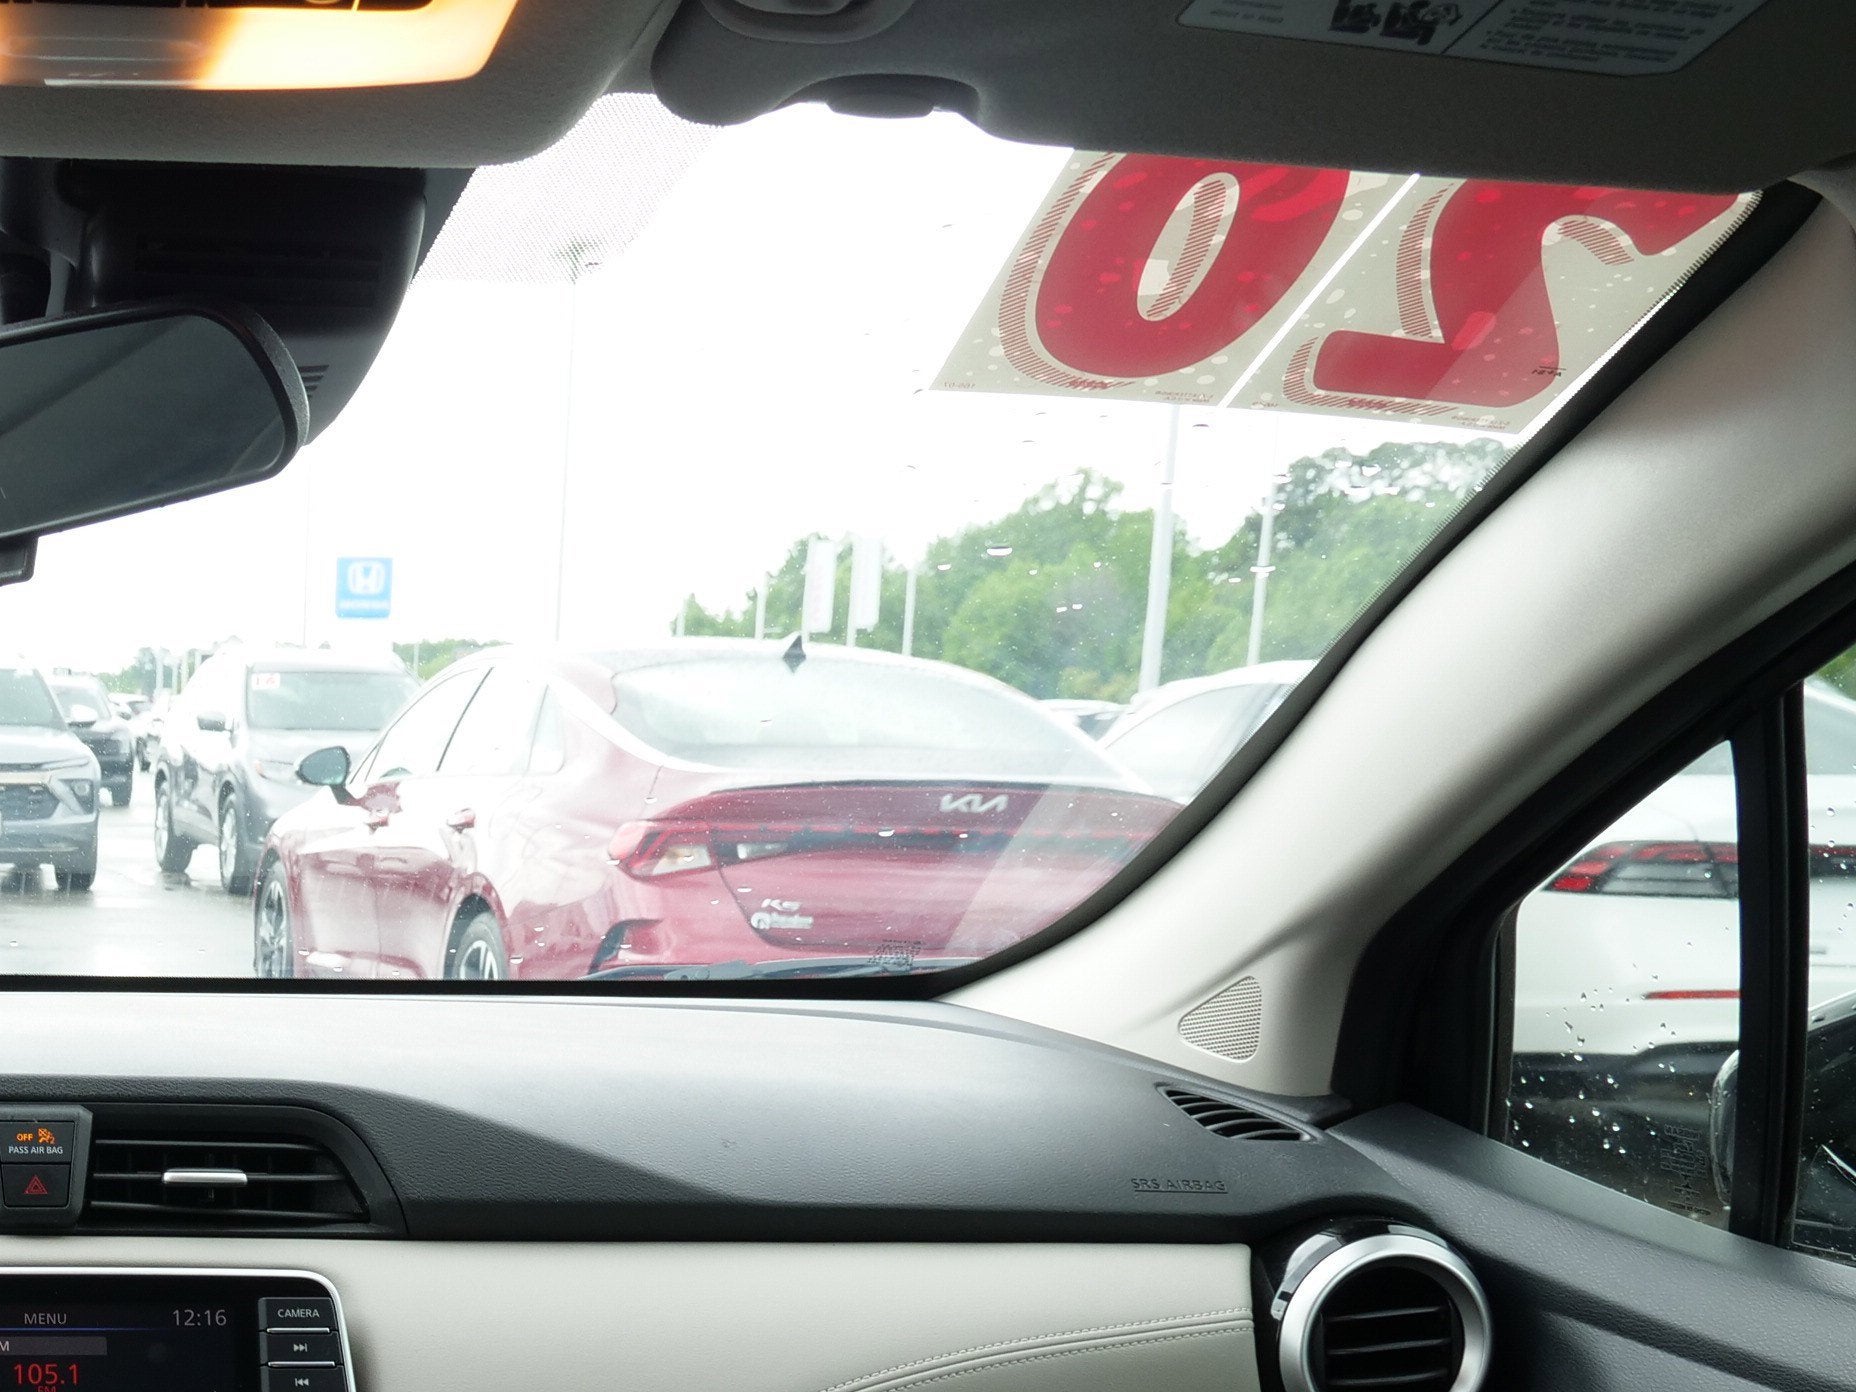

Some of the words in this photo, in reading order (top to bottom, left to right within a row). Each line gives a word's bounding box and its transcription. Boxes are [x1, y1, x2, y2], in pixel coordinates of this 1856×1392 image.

[16, 1132, 35, 1142] OFF
[8, 1145, 29, 1155] PASS
[30, 1145, 45, 1155] AIR
[46, 1145, 64, 1155] BAG
[1130, 1178, 1160, 1189] SRS
[1166, 1179, 1226, 1191] AIRBAG
[23, 1312, 68, 1326] MENU
[171, 1309, 228, 1327] 12:16
[277, 1308, 321, 1318] CAMERA
[13, 1363, 81, 1386] 105.1
